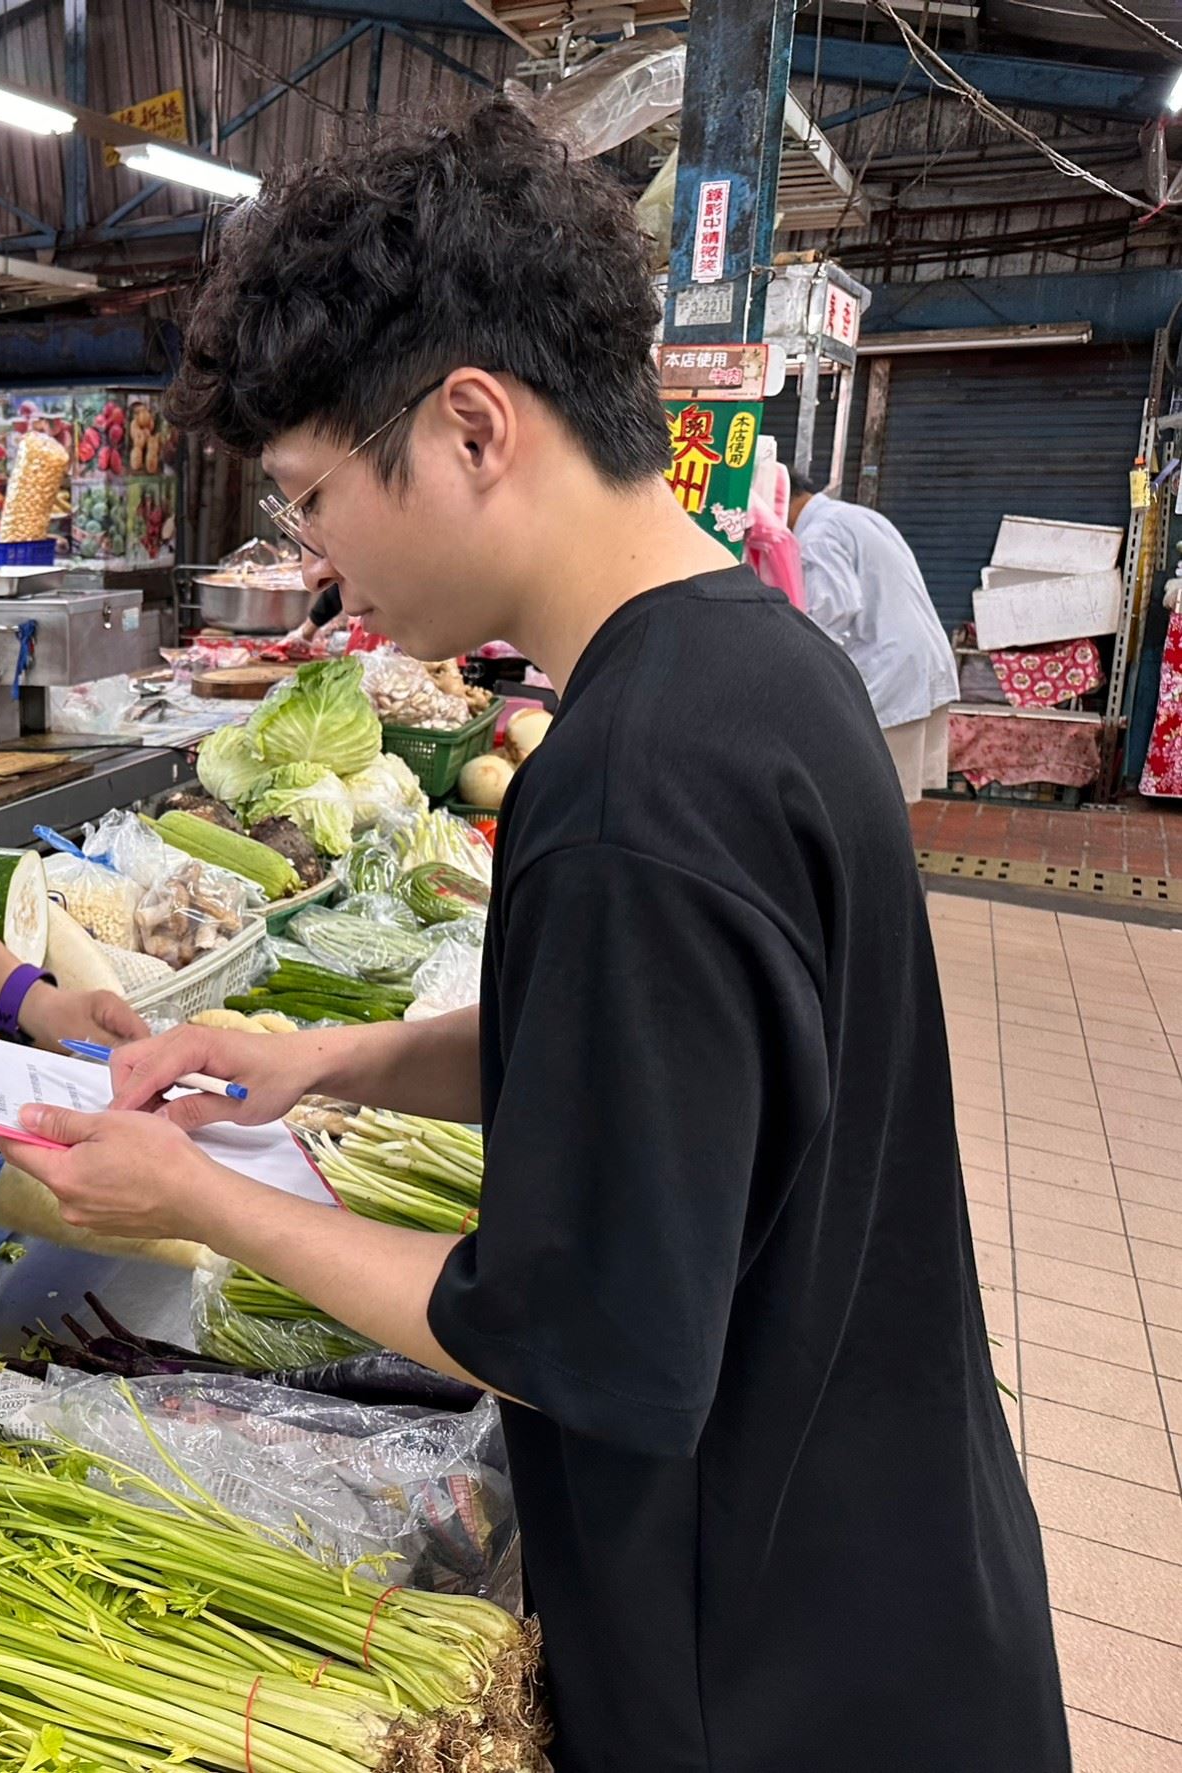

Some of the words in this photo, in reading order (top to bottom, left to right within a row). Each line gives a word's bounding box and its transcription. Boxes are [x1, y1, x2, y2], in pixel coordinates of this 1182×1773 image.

[698, 188, 723, 273] 錄影中請微笑
[664, 352, 728, 368] 本店使用
[709, 368, 742, 386] 牛肉
[728, 415, 750, 466] 本店使用
